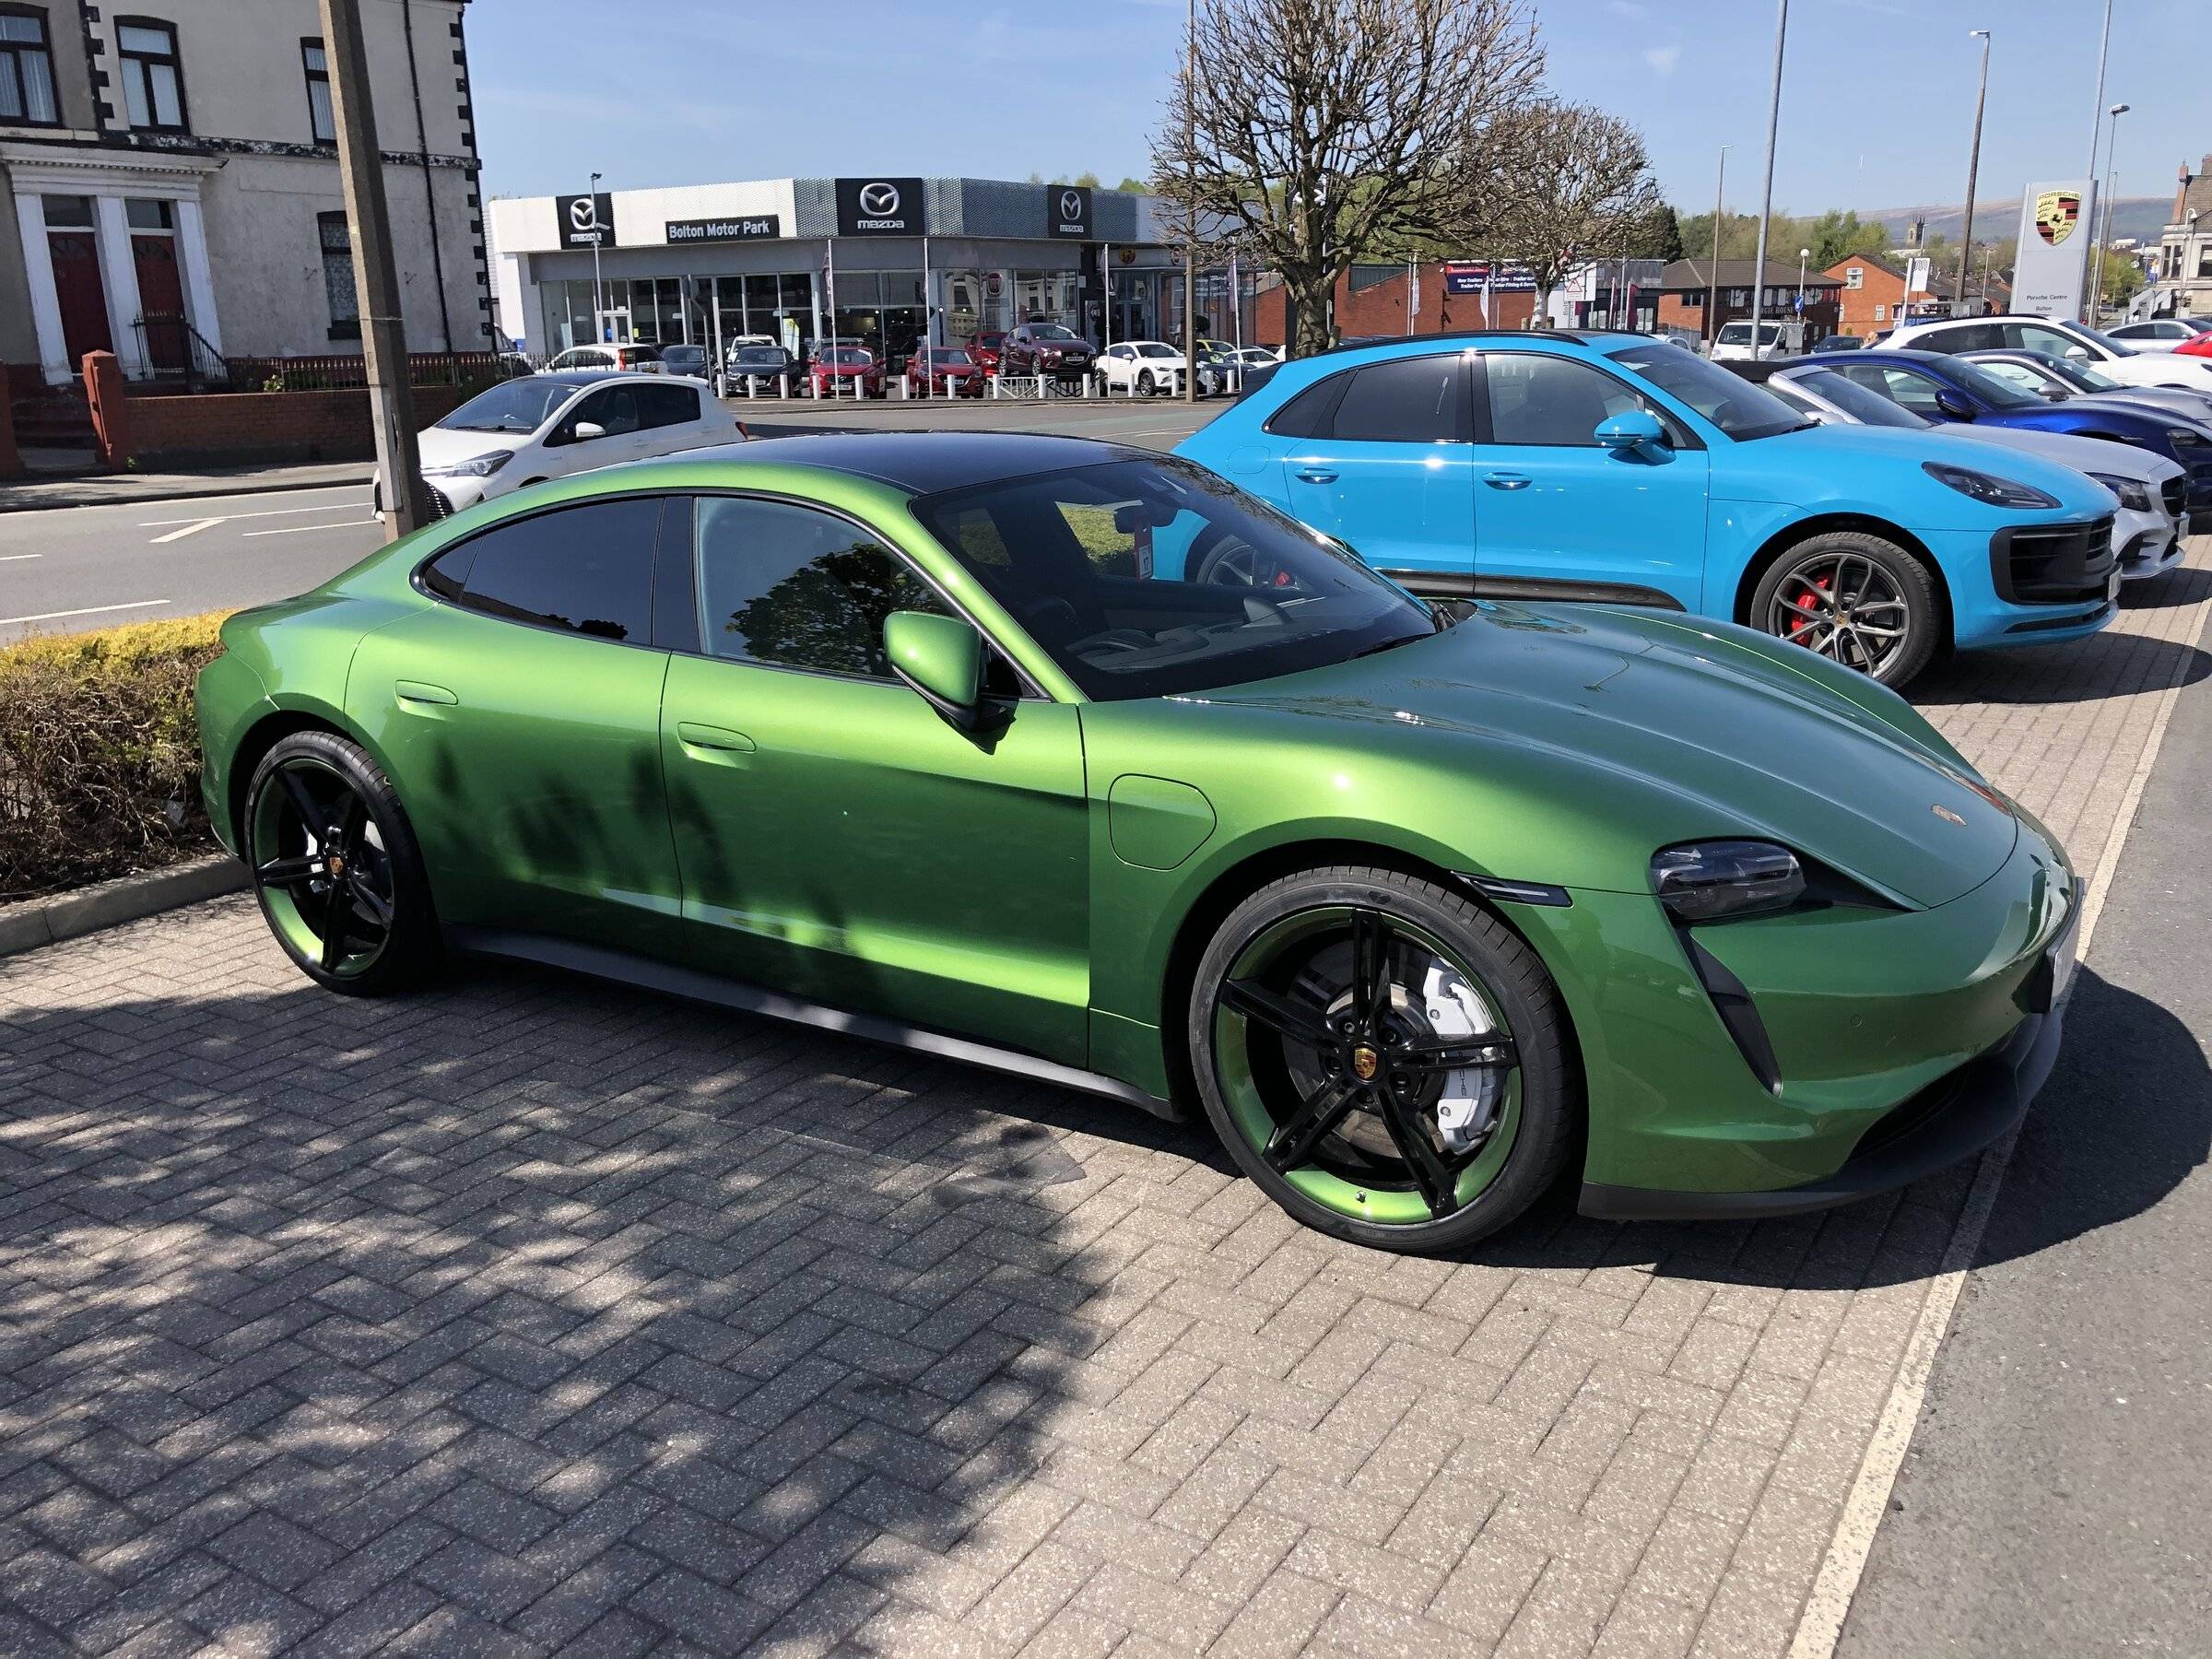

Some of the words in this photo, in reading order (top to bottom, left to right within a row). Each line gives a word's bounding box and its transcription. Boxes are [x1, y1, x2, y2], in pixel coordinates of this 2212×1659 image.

[2038, 191, 2080, 201] PORSCHE
[857, 219, 905, 229] mazda
[669, 224, 704, 240] Bolton
[706, 221, 740, 237] Motor
[743, 219, 771, 234] Park
[1775, 306, 1794, 314] HOUSE
